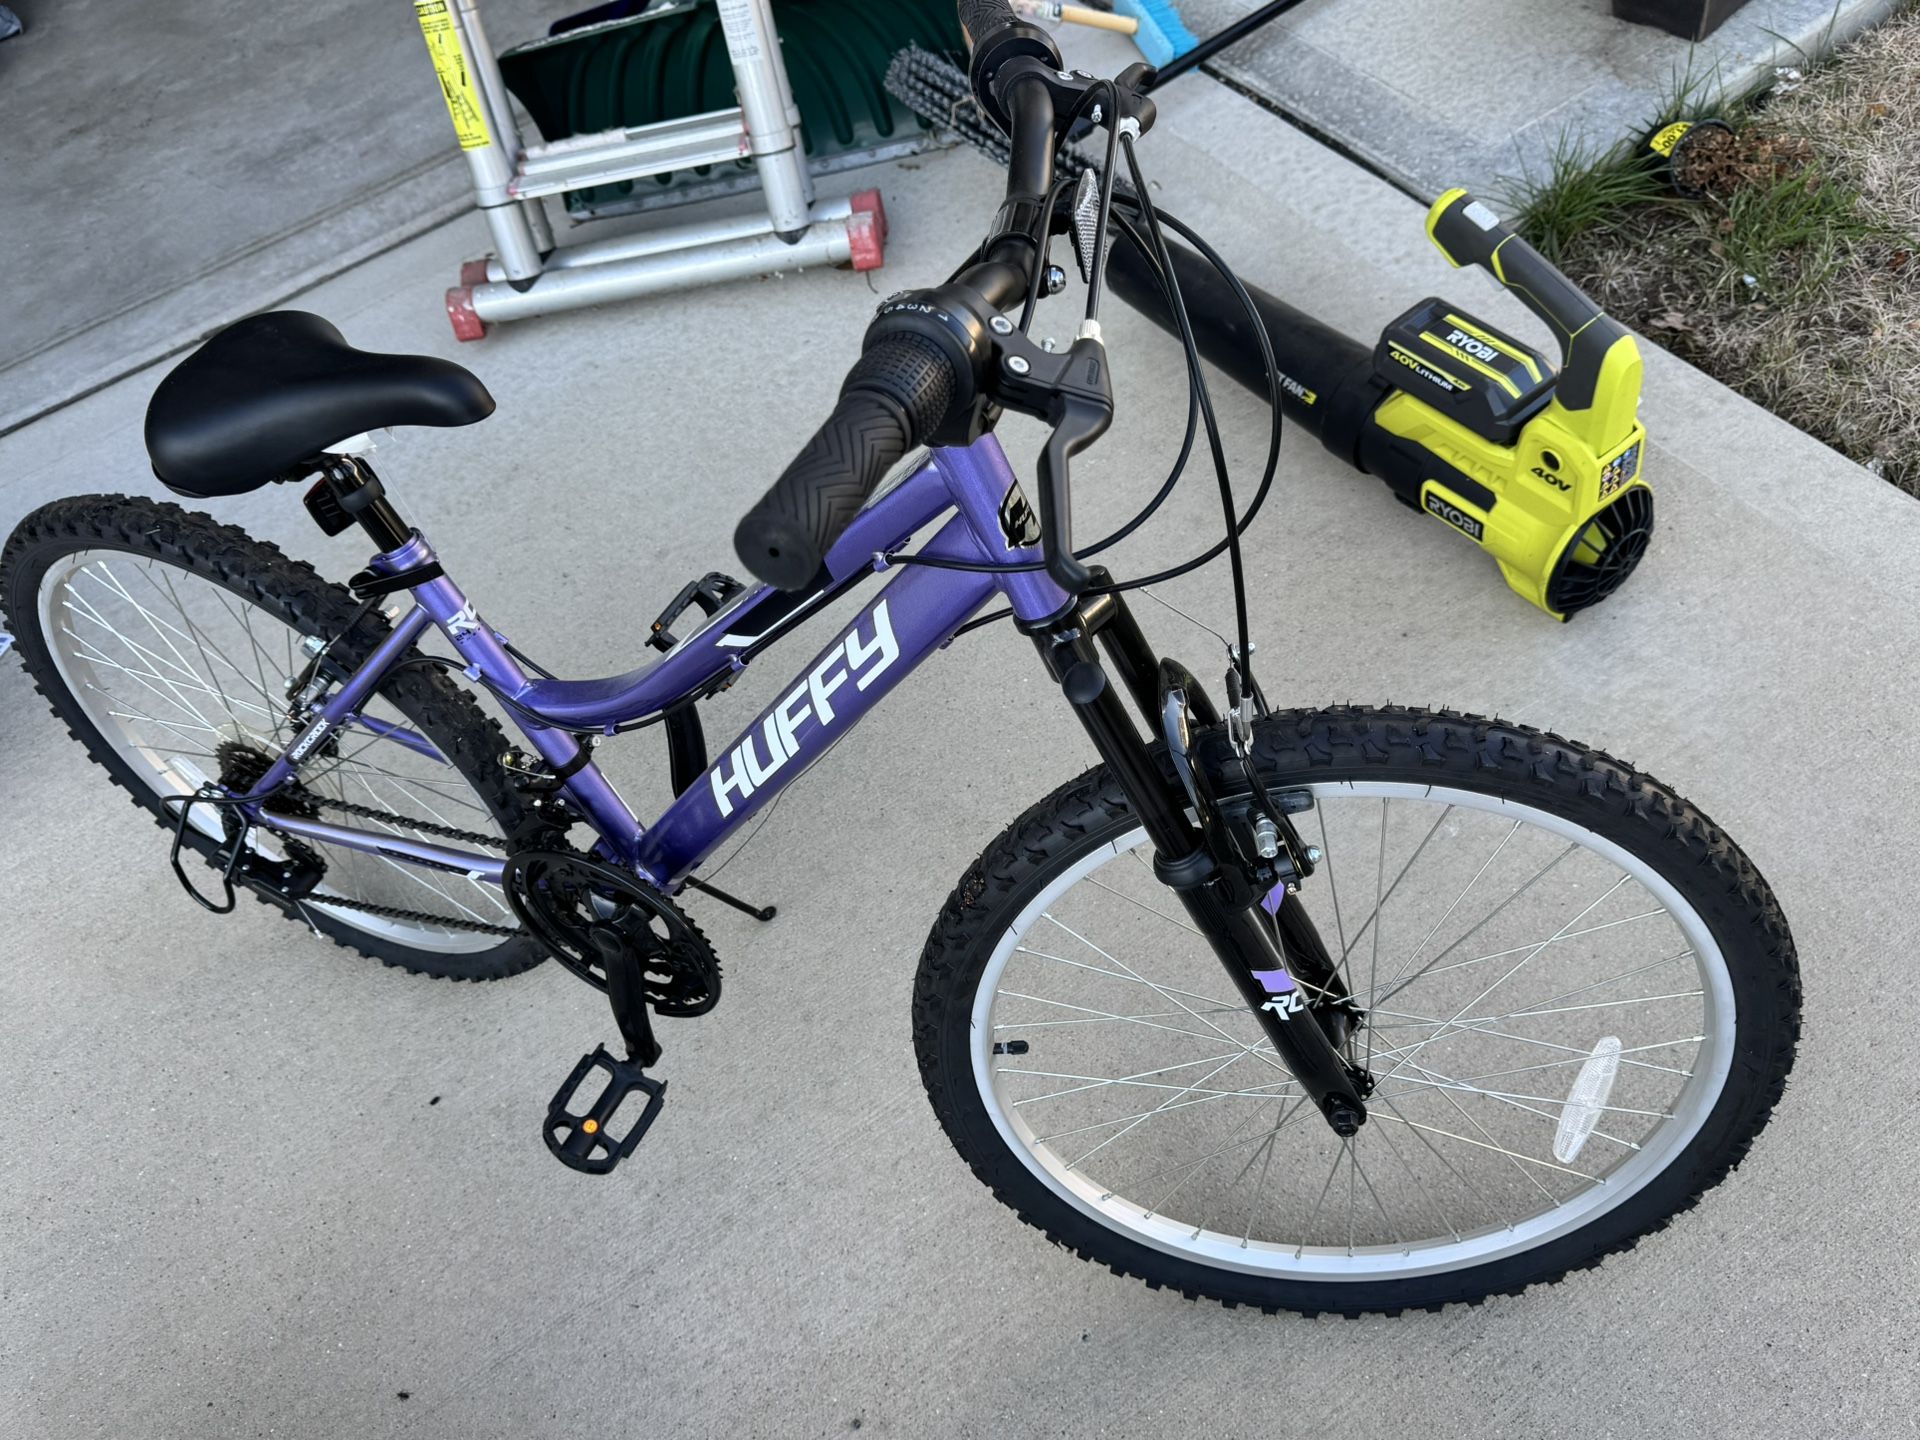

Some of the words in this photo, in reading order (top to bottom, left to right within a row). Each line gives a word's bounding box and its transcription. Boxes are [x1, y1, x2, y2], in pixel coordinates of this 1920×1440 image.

[895, 303, 906, 311] 4
[919, 305, 936, 313] 2
[1446, 329, 1499, 362] RYOBI
[1389, 350, 1418, 370] 40V
[1416, 365, 1454, 391] LITHIUM
[1282, 377, 1305, 397] FAN
[1530, 466, 1572, 492] 40V
[1428, 495, 1482, 537] RYOBI
[710, 598, 900, 819] HUFFY
[1260, 990, 1304, 1021] RC
